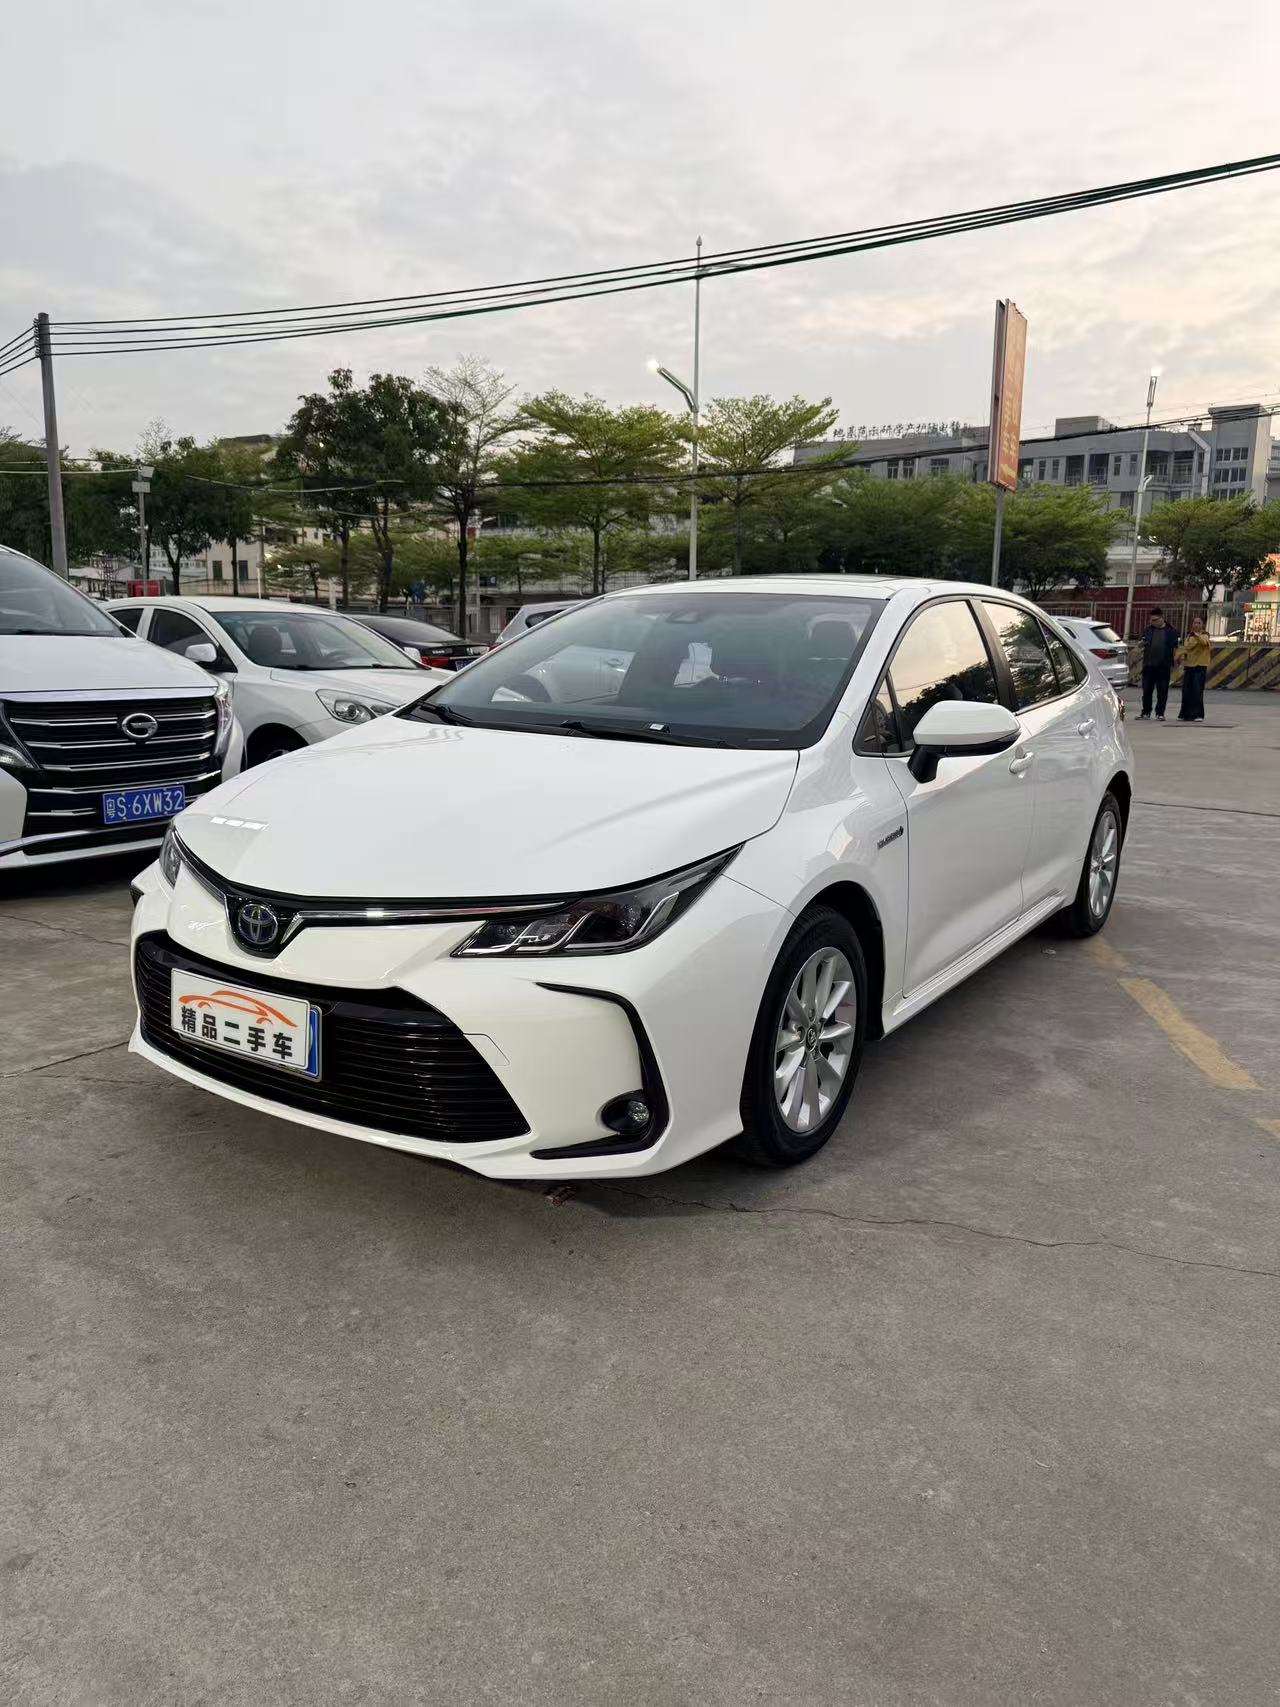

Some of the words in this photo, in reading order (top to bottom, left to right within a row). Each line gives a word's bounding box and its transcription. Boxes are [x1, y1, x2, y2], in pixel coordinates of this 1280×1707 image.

[181, 1006, 293, 1060] 精品二手车
